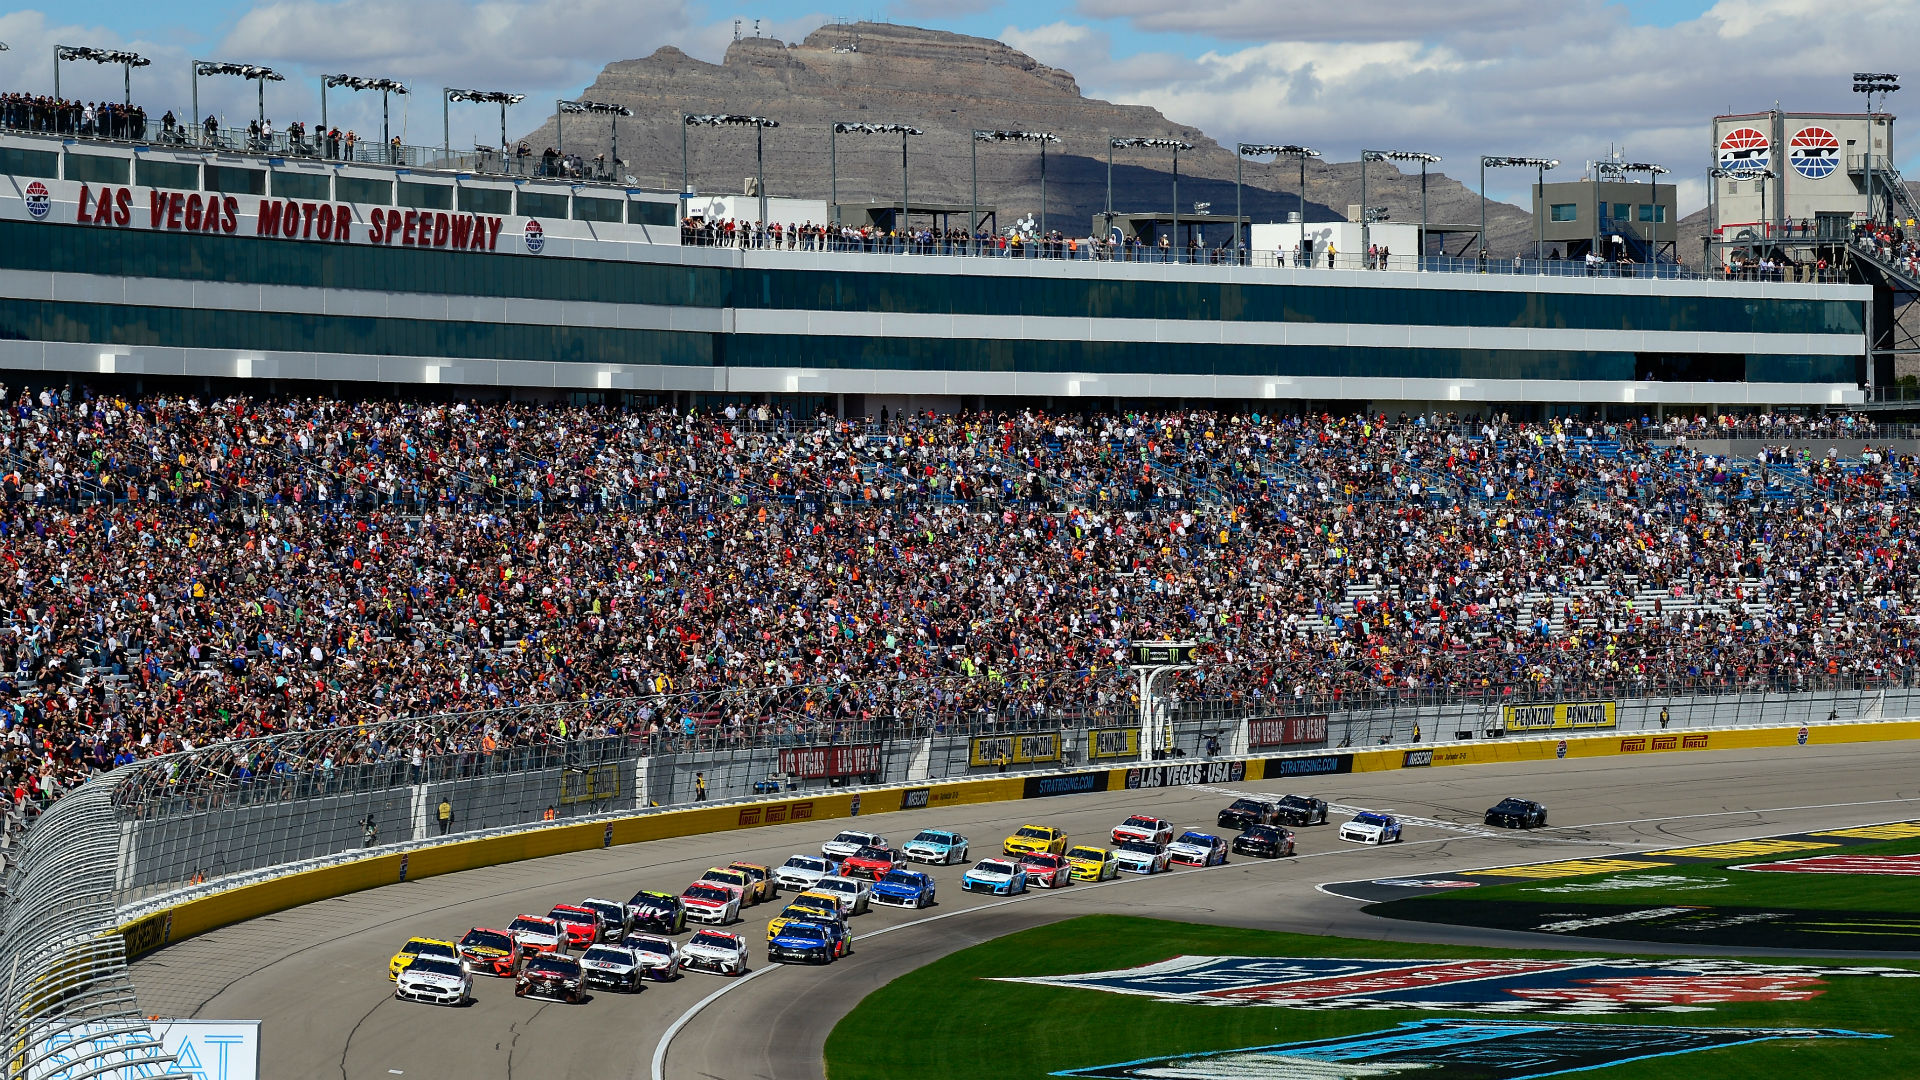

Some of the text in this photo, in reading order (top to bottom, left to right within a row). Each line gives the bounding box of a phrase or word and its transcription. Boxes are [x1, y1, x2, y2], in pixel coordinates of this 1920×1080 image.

[77, 185, 502, 250] LAS VEGAS MOTOR SPEEDWAY
[1514, 707, 1556, 727] PENNZOIL
[1566, 705, 1607, 723] PENNZOIL
[1249, 720, 1284, 744] LAS VEGAS
[1293, 718, 1326, 740] LAS VEGAS
[979, 738, 1012, 760] PENNZOIL
[1021, 735, 1054, 758] PENNZOIL
[1097, 730, 1129, 753] PENNZOIL
[1620, 738, 1646, 752] PIRELLI
[1651, 736, 1678, 751] PIRELLI
[1682, 735, 1709, 749] PIRELLI
[798, 751, 825, 775] VEGAS
[837, 749, 853, 773] LAS
[1280, 758, 1338, 774] STRATRISING.COM
[1409, 751, 1432, 765] NASCAR
[1039, 776, 1095, 794] STRATRISING.COM
[1140, 767, 1162, 788] LAS
[908, 790, 929, 806] NASCAR
[739, 808, 762, 826] PIRELLI
[765, 805, 787, 822] PIRELLI
[791, 802, 814, 819] PIRELLI
